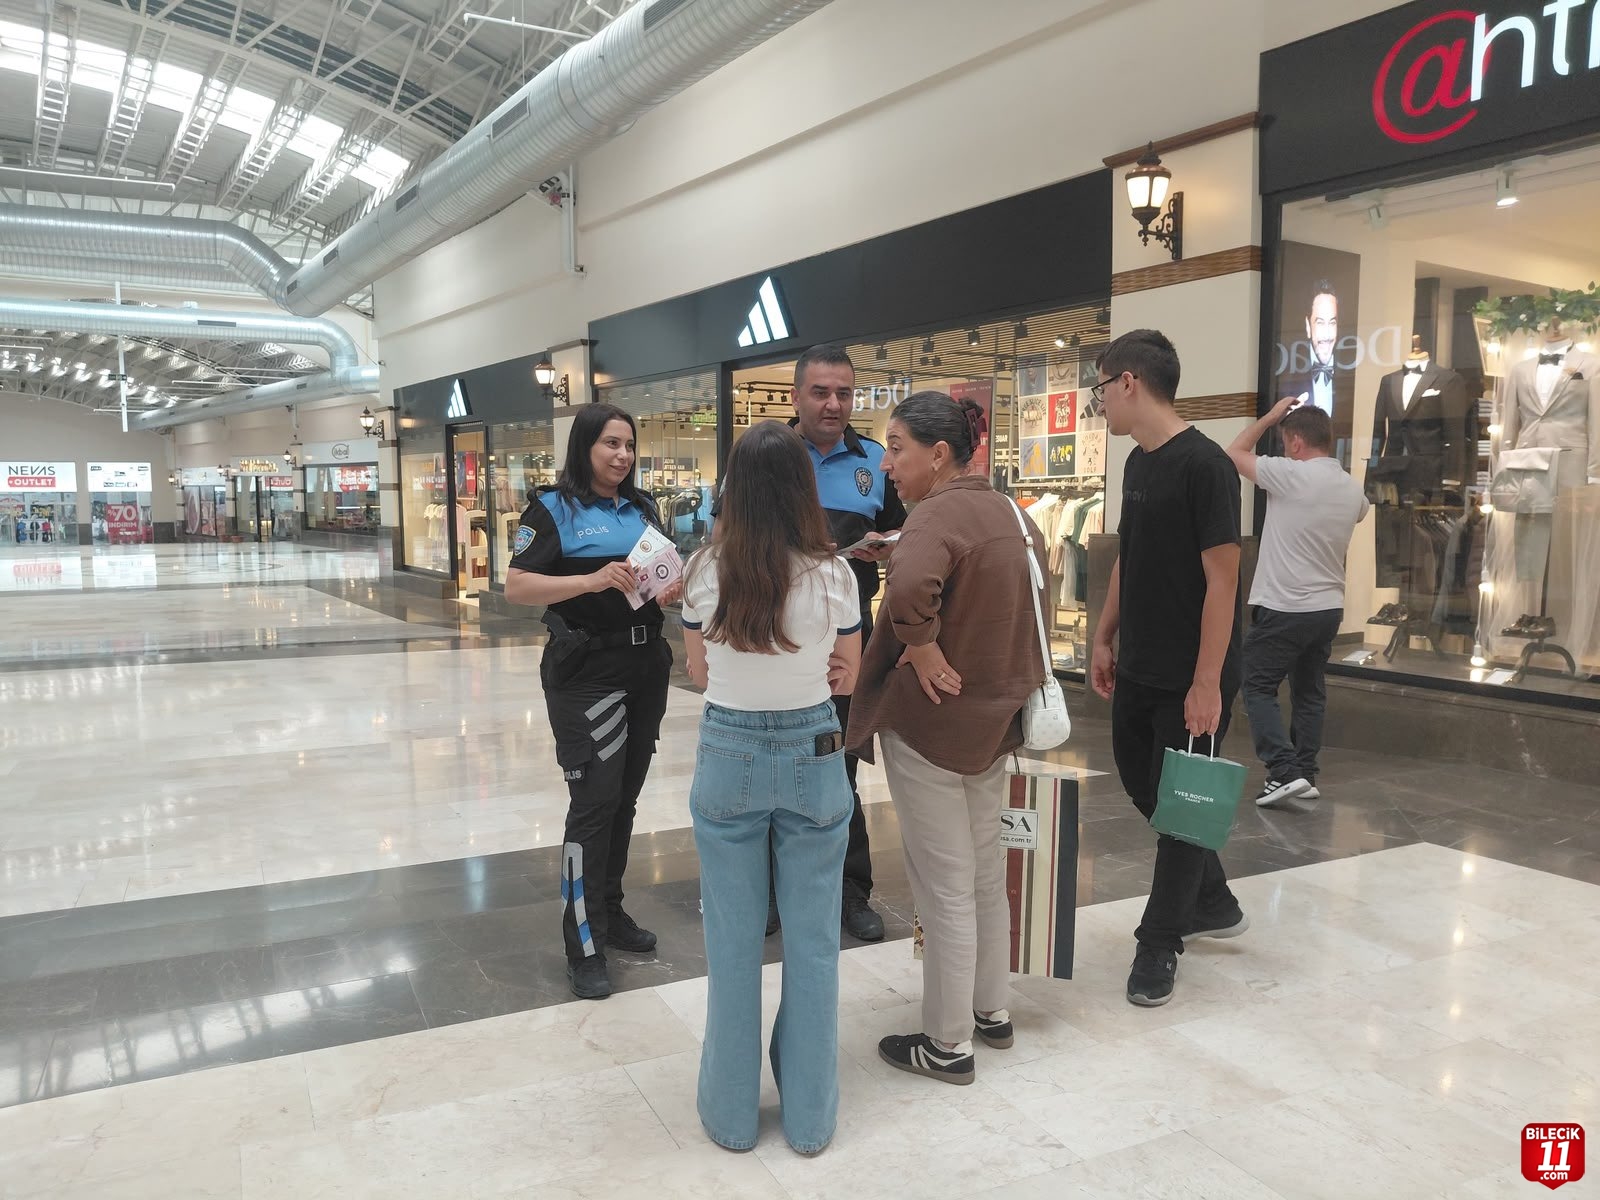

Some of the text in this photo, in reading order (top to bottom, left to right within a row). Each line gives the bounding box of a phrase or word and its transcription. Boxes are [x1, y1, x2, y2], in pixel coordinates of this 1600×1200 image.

[8, 465, 56, 476] NEVAS
[14, 478, 53, 486] OUTLET
[107, 505, 137, 521] %70
[1174, 790, 1214, 803] YVES ROCHER
